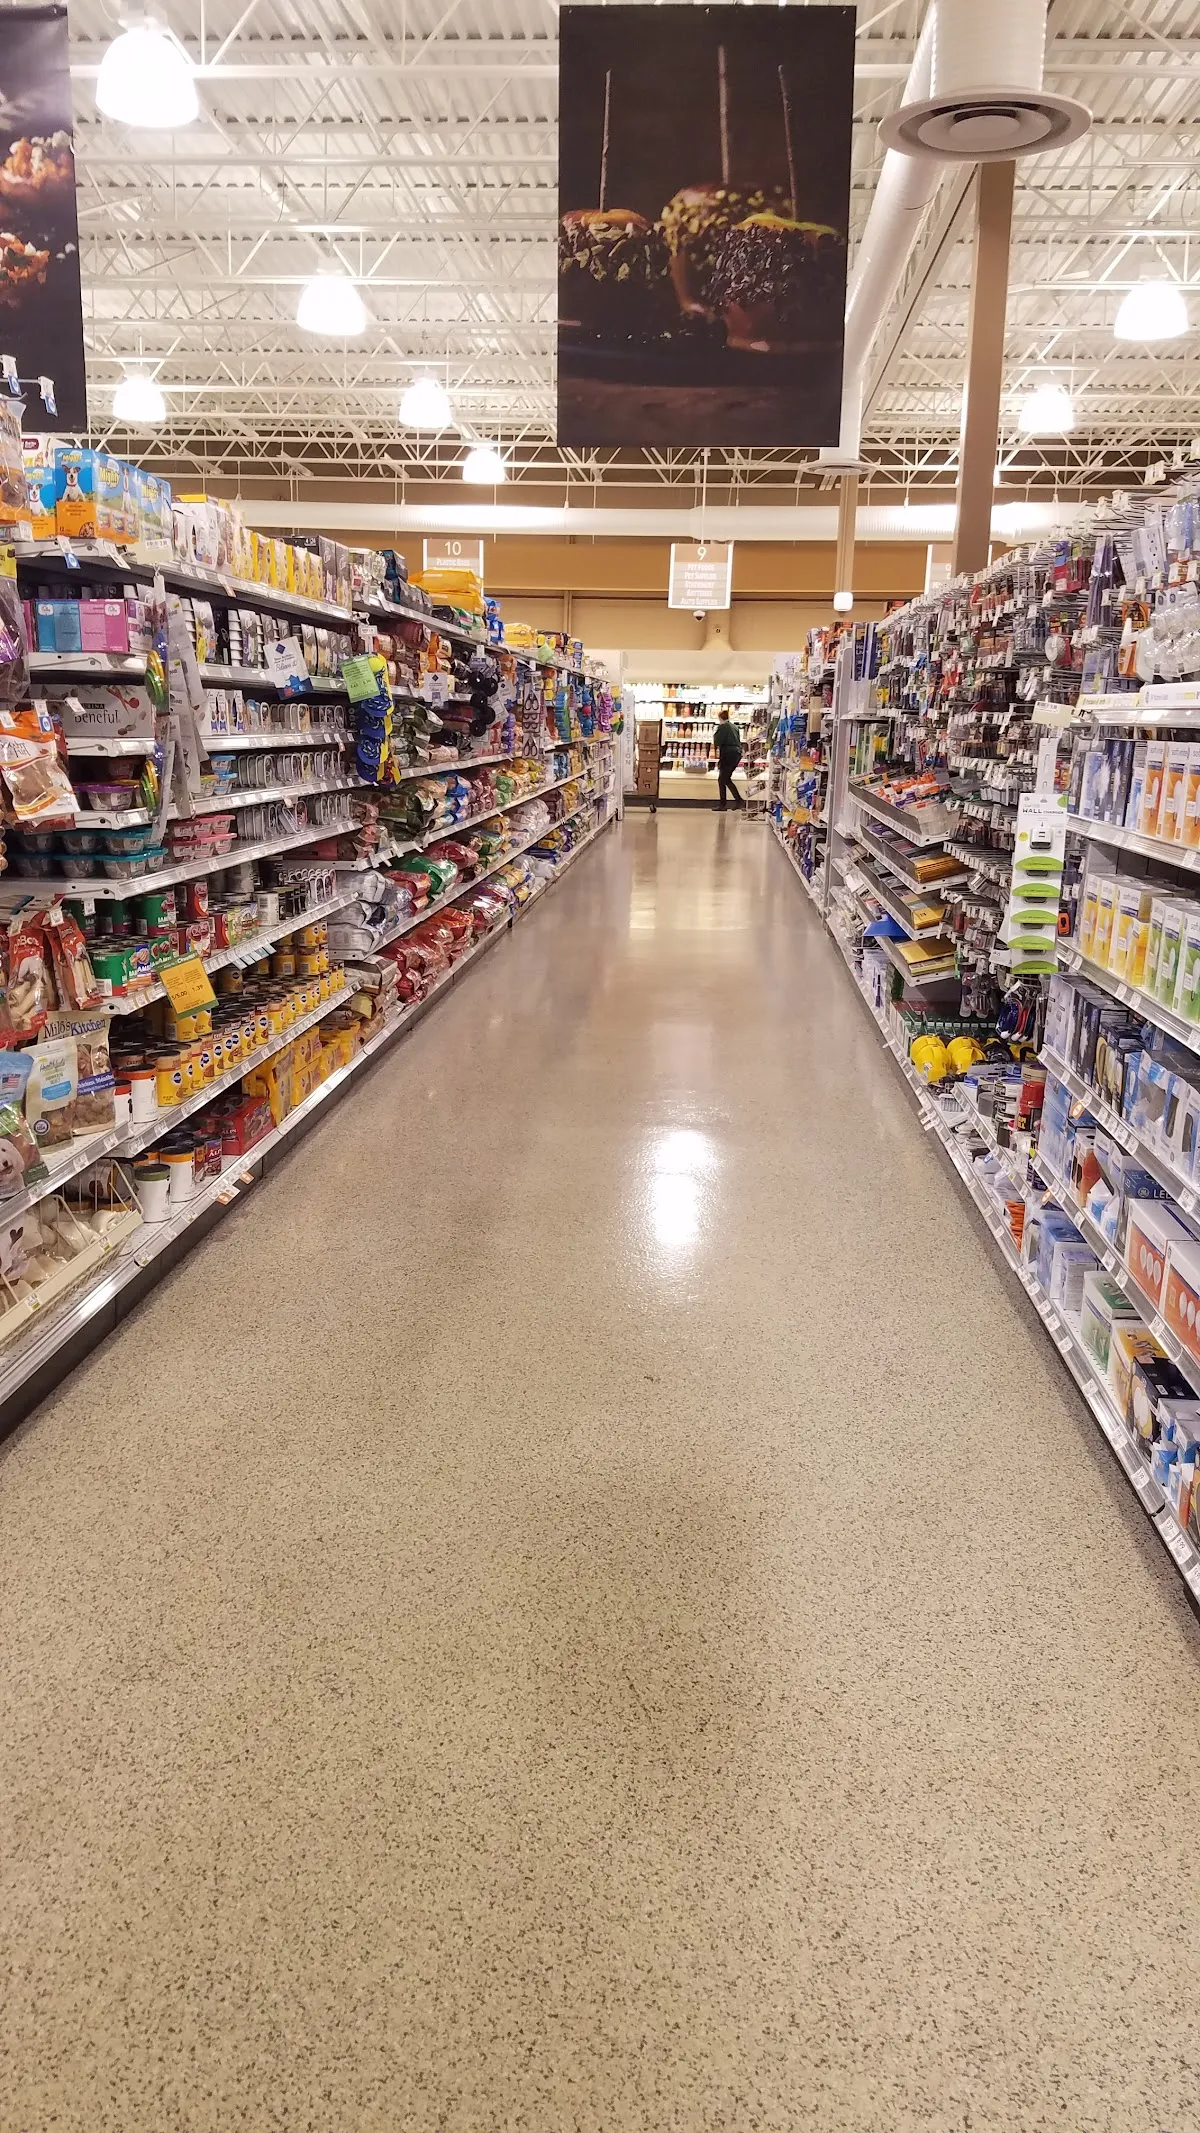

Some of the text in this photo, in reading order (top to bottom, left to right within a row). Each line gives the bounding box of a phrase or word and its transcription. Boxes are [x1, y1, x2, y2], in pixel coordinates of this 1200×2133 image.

[444, 541, 462, 556] 10
[697, 546, 707, 561] 9
[43, 1017, 107, 1039] Milo's Kitchen
[1153, 1189, 1172, 1199] LED
